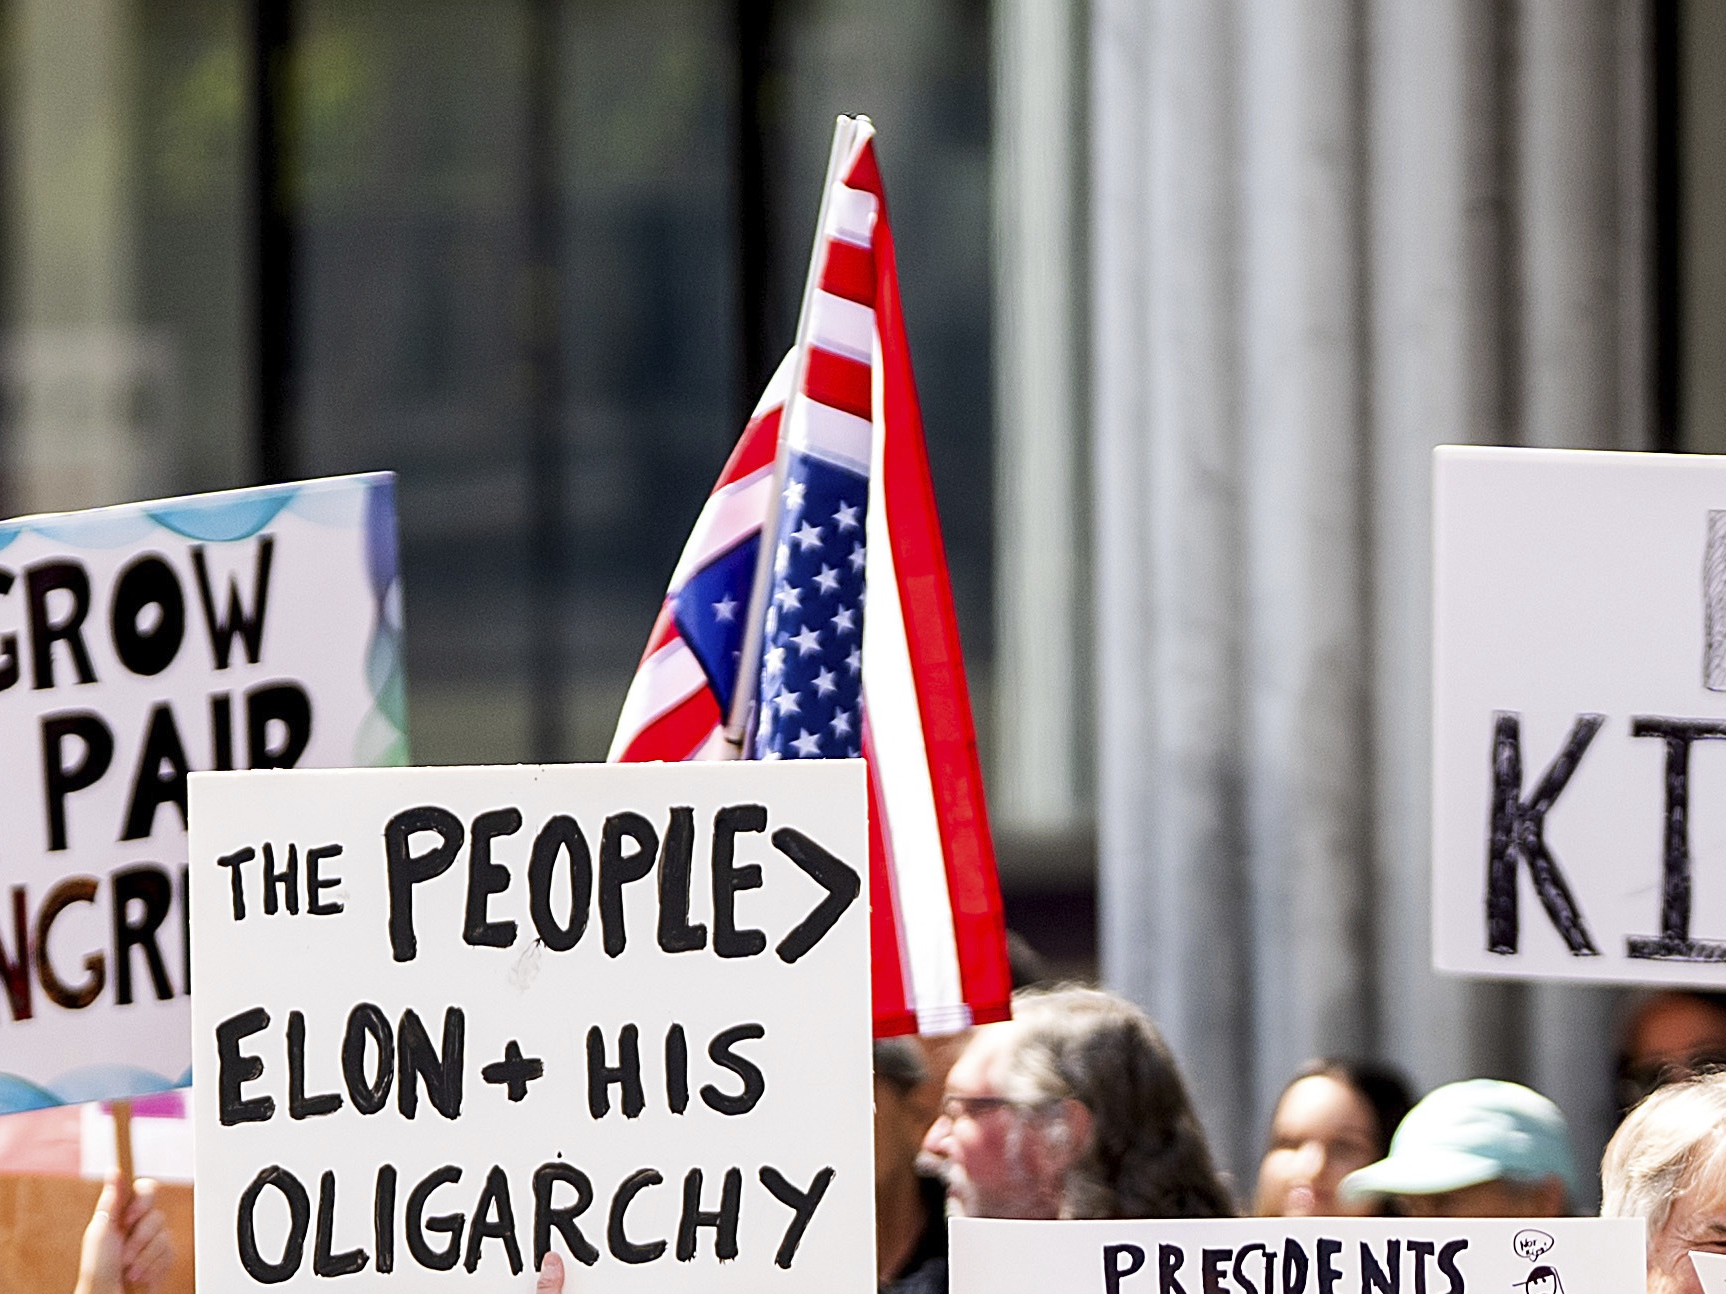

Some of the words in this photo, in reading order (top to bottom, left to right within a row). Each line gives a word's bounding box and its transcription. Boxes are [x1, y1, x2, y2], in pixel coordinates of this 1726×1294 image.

[217, 843, 344, 921] THE
[215, 1002, 465, 1126] ELON
[587, 1021, 766, 1120] HIS
[237, 1160, 837, 1285] OLIGARCHY
